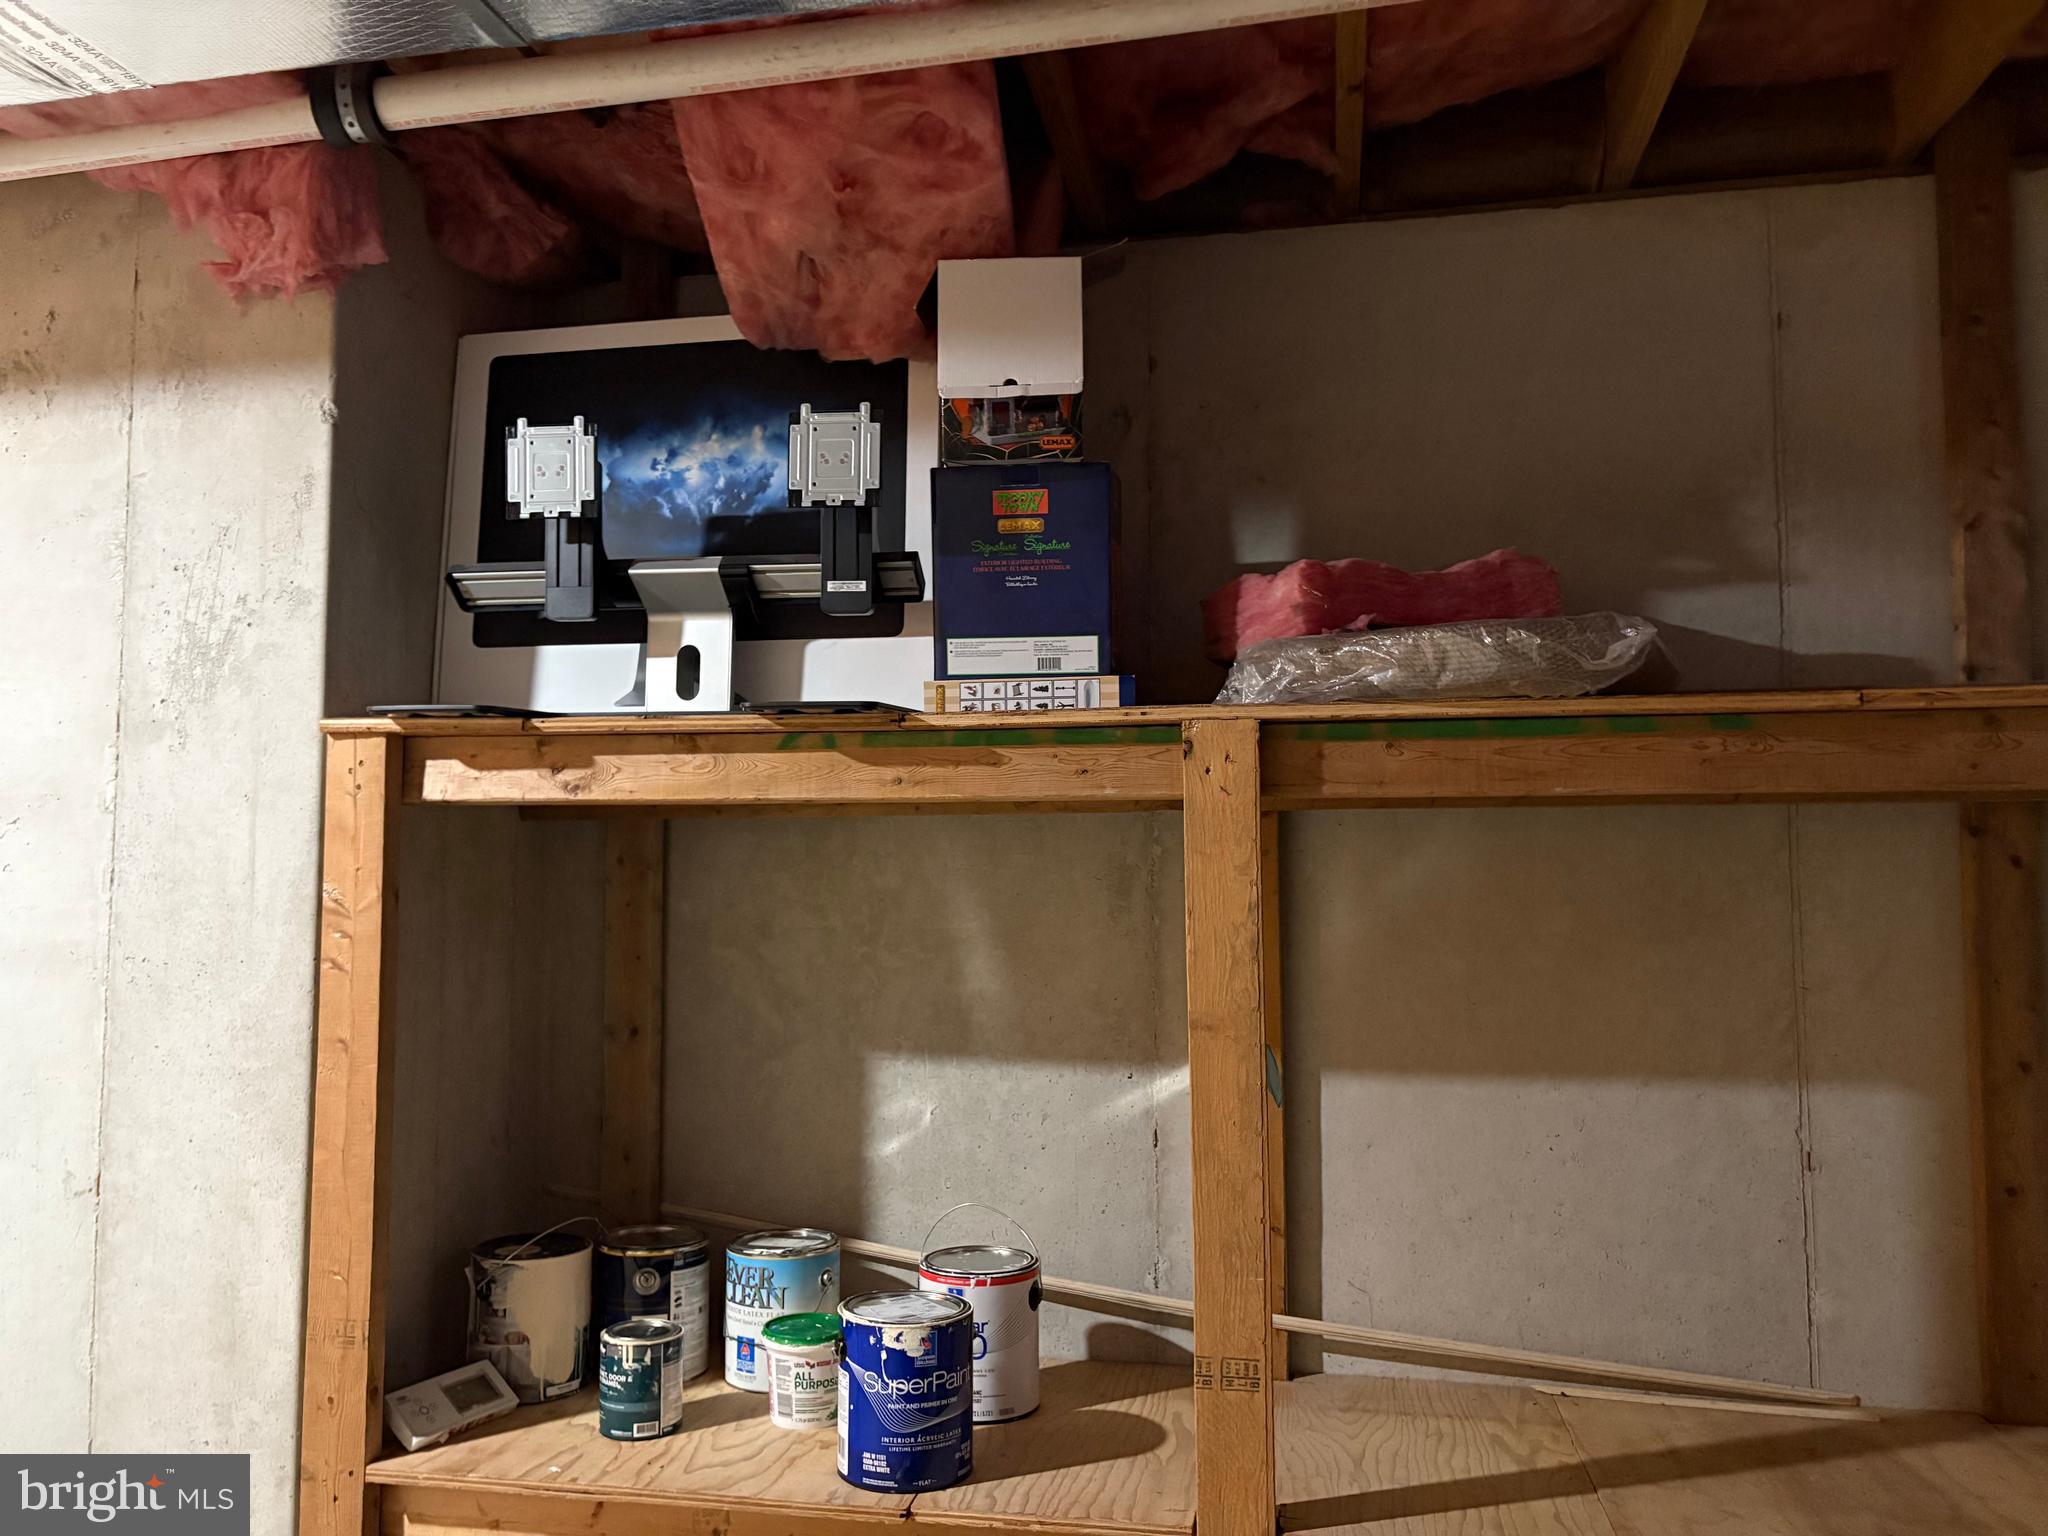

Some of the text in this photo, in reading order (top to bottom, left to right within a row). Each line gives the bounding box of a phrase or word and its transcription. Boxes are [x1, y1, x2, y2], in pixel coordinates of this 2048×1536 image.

[1042, 438, 1073, 446] LEMAX
[1000, 520, 1041, 530] LEMAX
[1023, 538, 1071, 556] Signature
[727, 1256, 775, 1288] EVER
[727, 1282, 790, 1309] LEAN
[743, 1309, 764, 1318] LATEX
[794, 1372, 814, 1380] ALL
[864, 1366, 970, 1399] SuperPaint
[876, 1466, 890, 1474] WHITE
